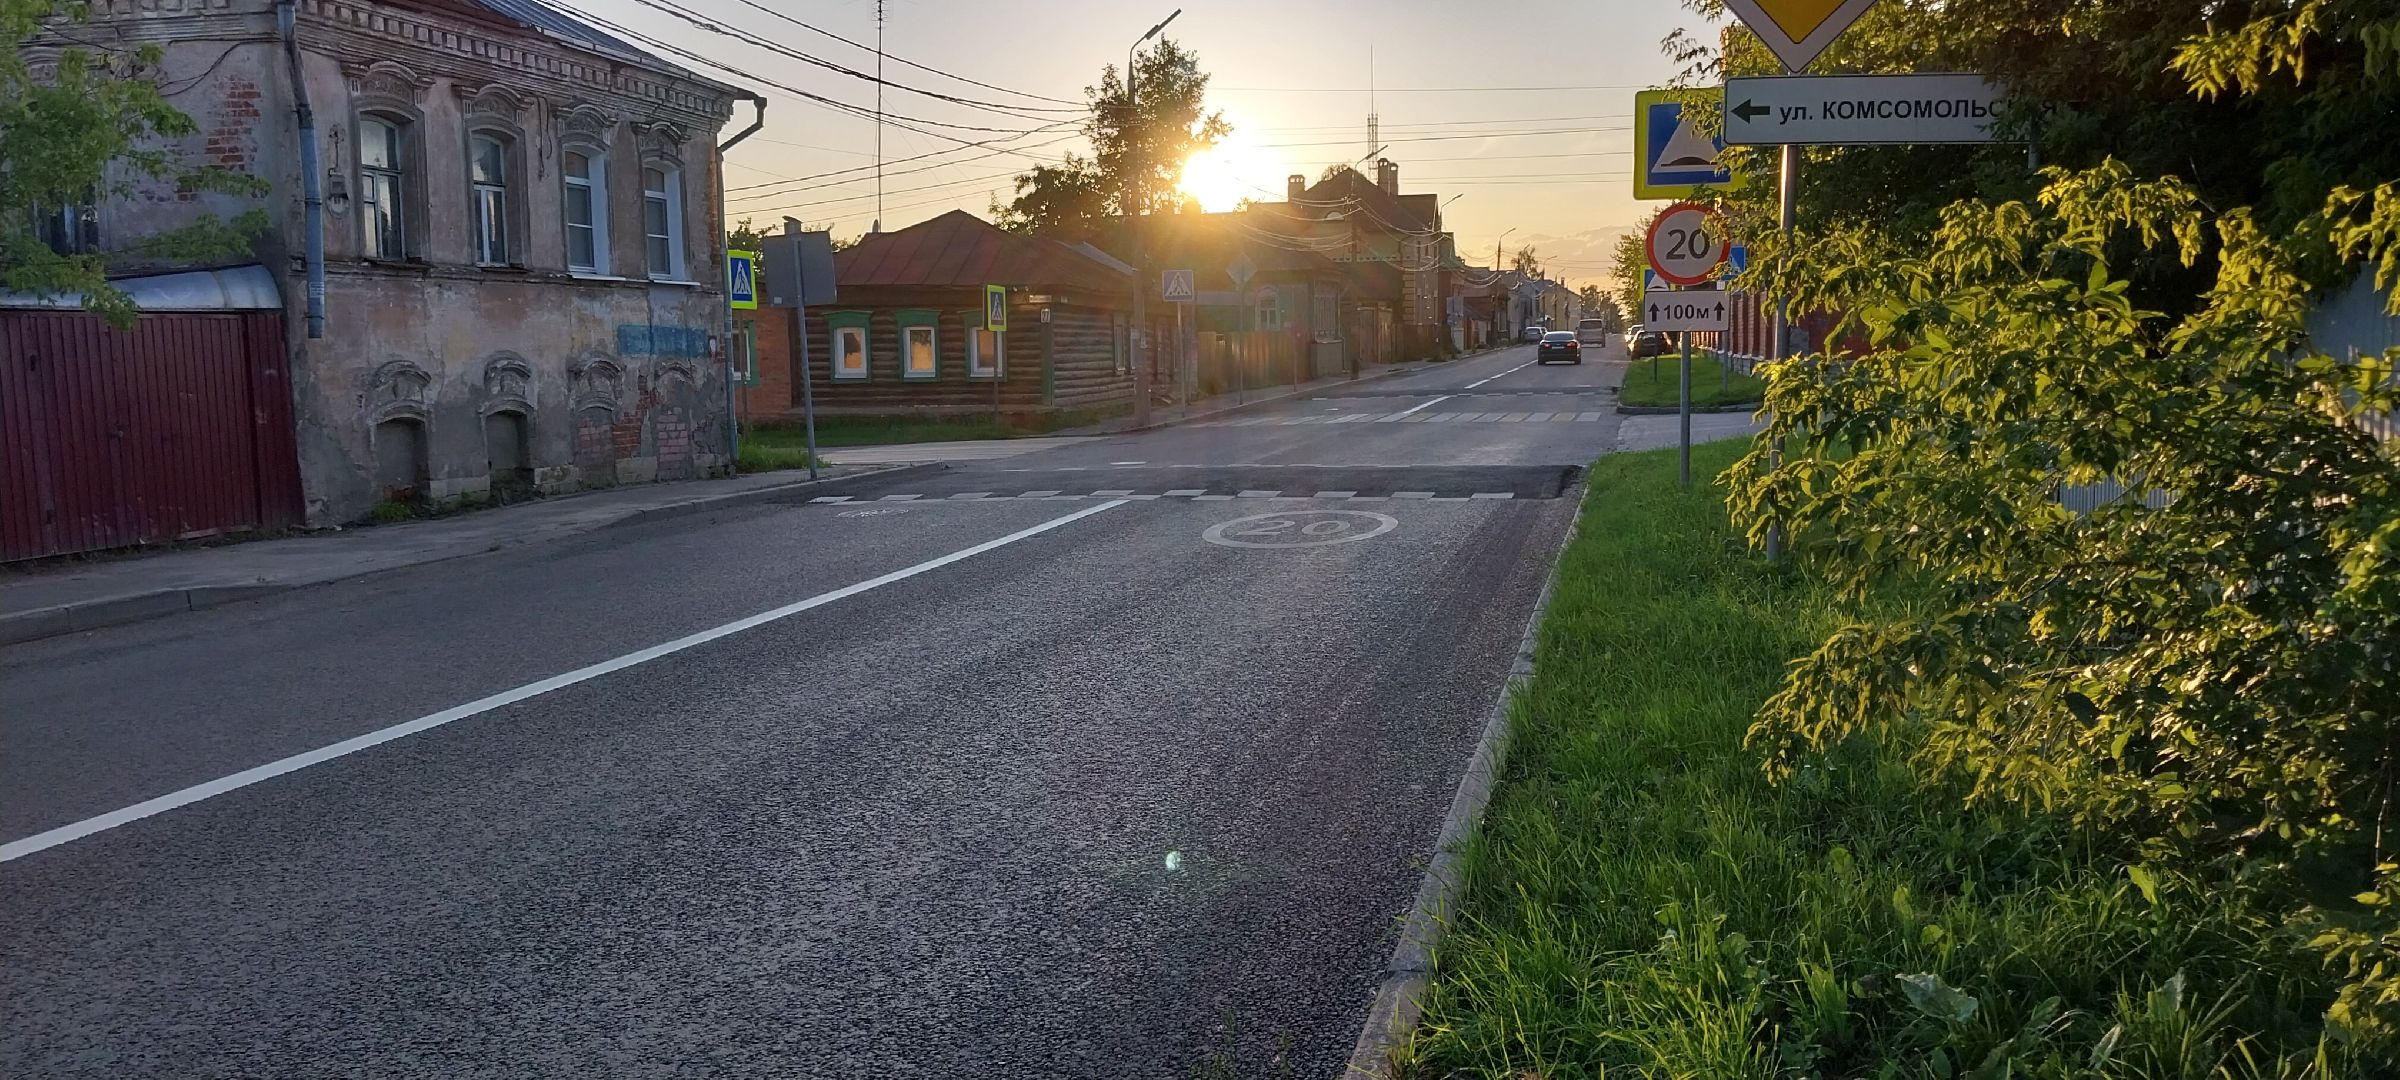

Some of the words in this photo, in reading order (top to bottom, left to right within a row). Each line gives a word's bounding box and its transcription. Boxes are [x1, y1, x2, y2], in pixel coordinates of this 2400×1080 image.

[1779, 104, 1813, 125] ул.
[1666, 229, 1710, 260] 20
[1236, 520, 1351, 536] 20
